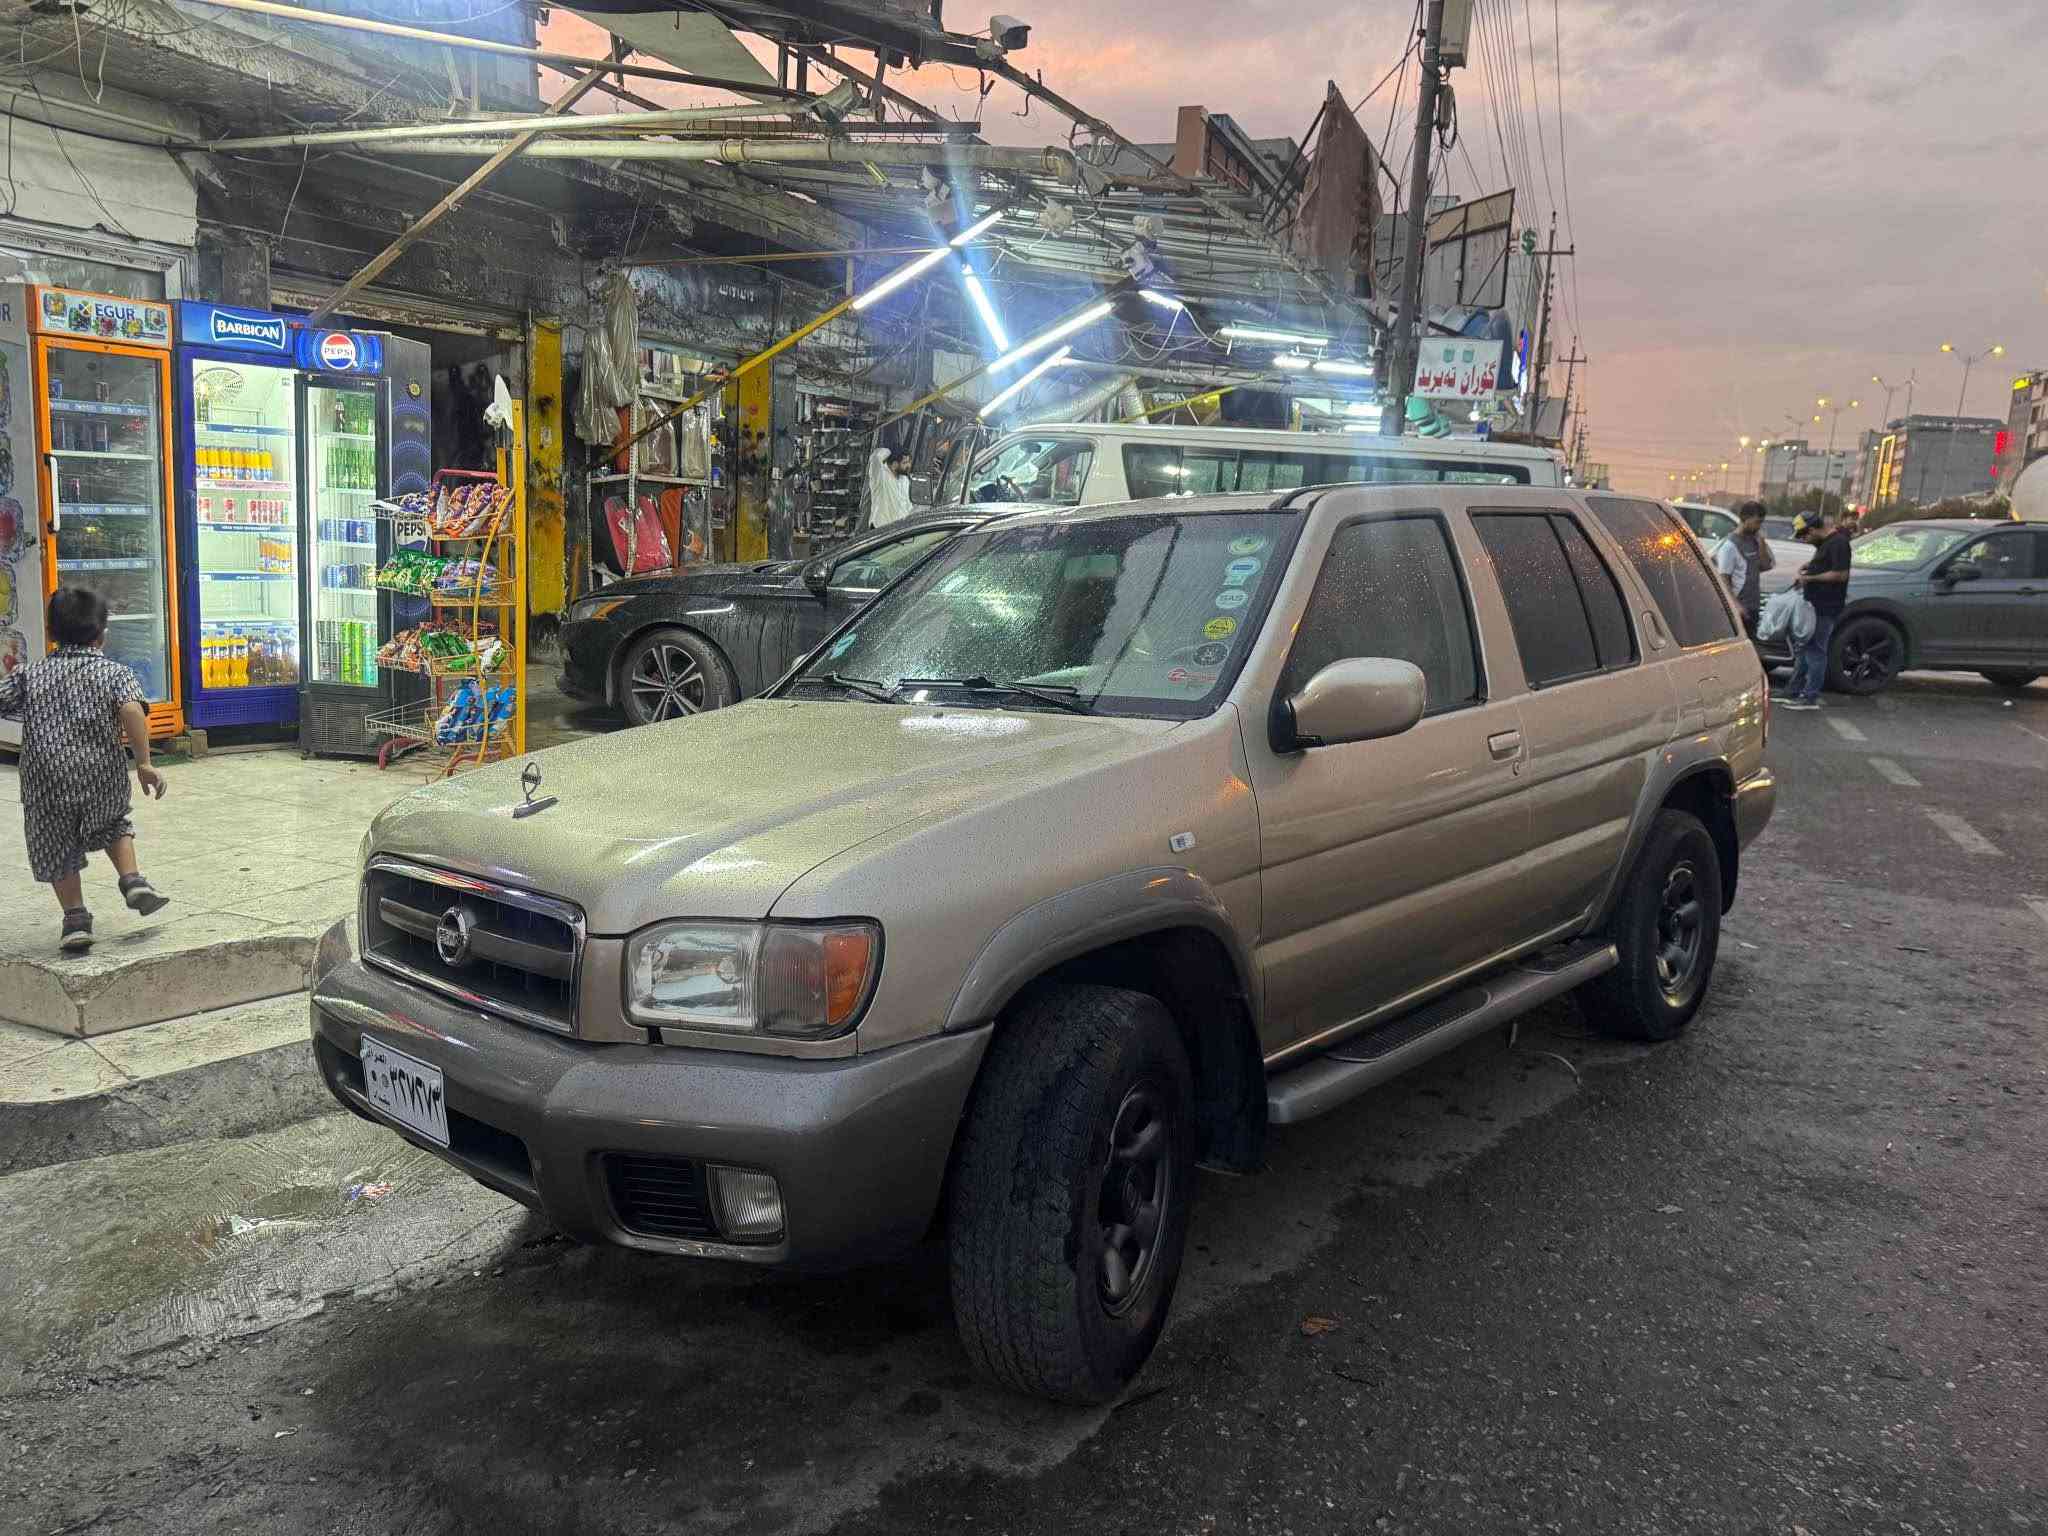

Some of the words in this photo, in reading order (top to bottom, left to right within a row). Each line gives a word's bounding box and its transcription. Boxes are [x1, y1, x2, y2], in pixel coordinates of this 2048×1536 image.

[0, 303, 12, 322] R
[216, 319, 280, 340] BARBICAN
[324, 347, 353, 356] PEPSI
[397, 521, 427, 537] PEPSI
